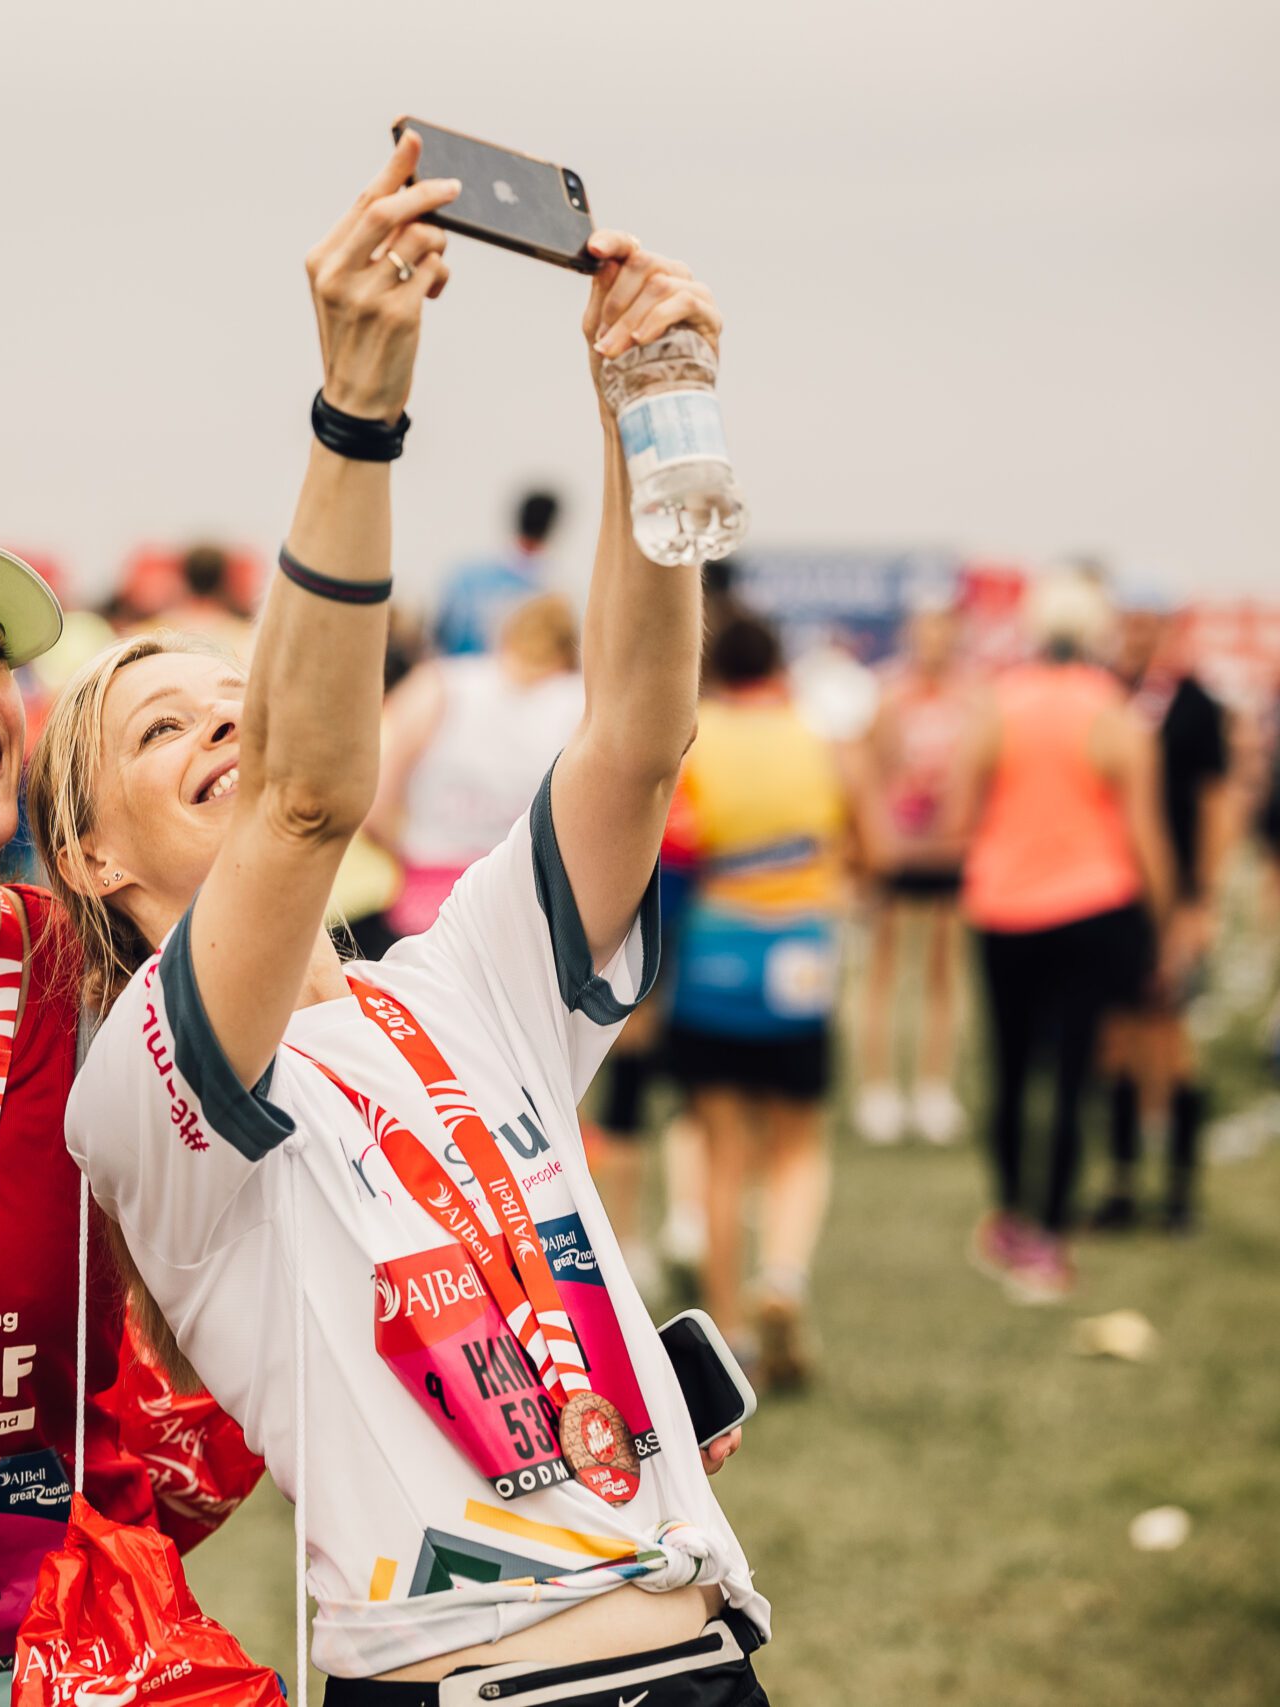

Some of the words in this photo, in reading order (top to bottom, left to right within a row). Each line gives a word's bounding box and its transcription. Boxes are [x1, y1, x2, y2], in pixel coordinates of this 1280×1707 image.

[366, 996, 417, 1041] 2023
[521, 1160, 563, 1194] people
[488, 1176, 532, 1239] AJBell
[440, 1207, 493, 1265] AJBell
[548, 1230, 577, 1252] AJBell
[404, 1263, 487, 1318] AJBell
[10, 1467, 46, 1485] AJBell
[10, 1488, 36, 1505] great
[45, 1482, 70, 1497] north
[141, 1658, 193, 1694] series
